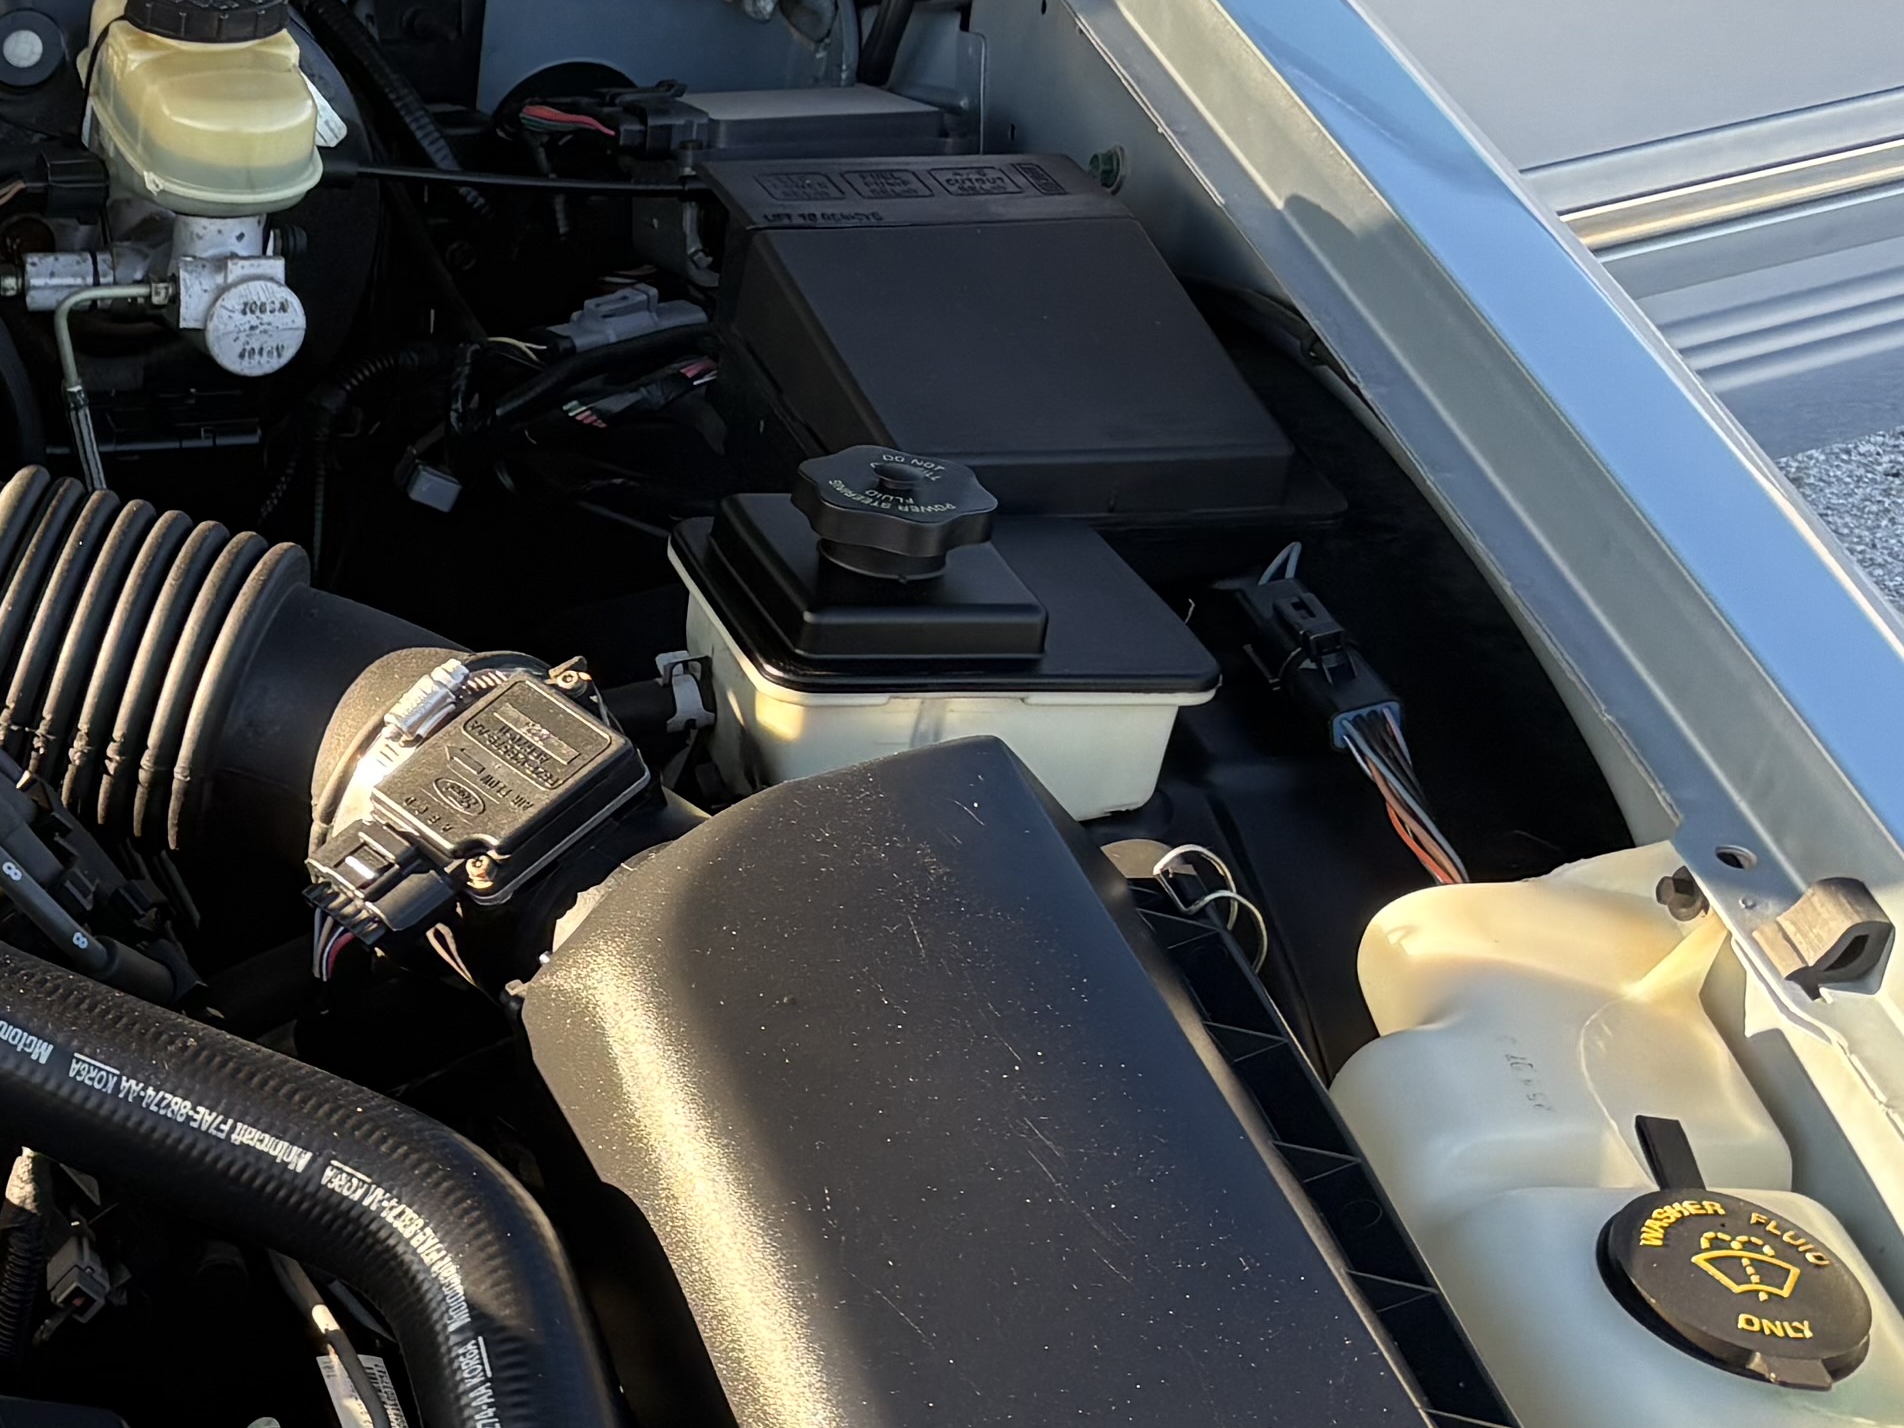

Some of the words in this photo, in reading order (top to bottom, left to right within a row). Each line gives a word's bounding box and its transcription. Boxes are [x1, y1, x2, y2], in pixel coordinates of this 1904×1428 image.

[910, 458, 946, 472] NOT
[828, 478, 892, 509] STEERING
[865, 489, 913, 504] FLUID
[897, 502, 957, 513] POWER
[1, 861, 22, 881] 8
[72, 931, 89, 949] 8
[119, 1075, 233, 1141] F7AE-8B274-AA
[231, 1121, 314, 1173] Motorcraft
[1639, 1200, 1727, 1247] WASHER
[1749, 1212, 1831, 1267] FLUID
[1737, 1312, 1814, 1339] ONLY
